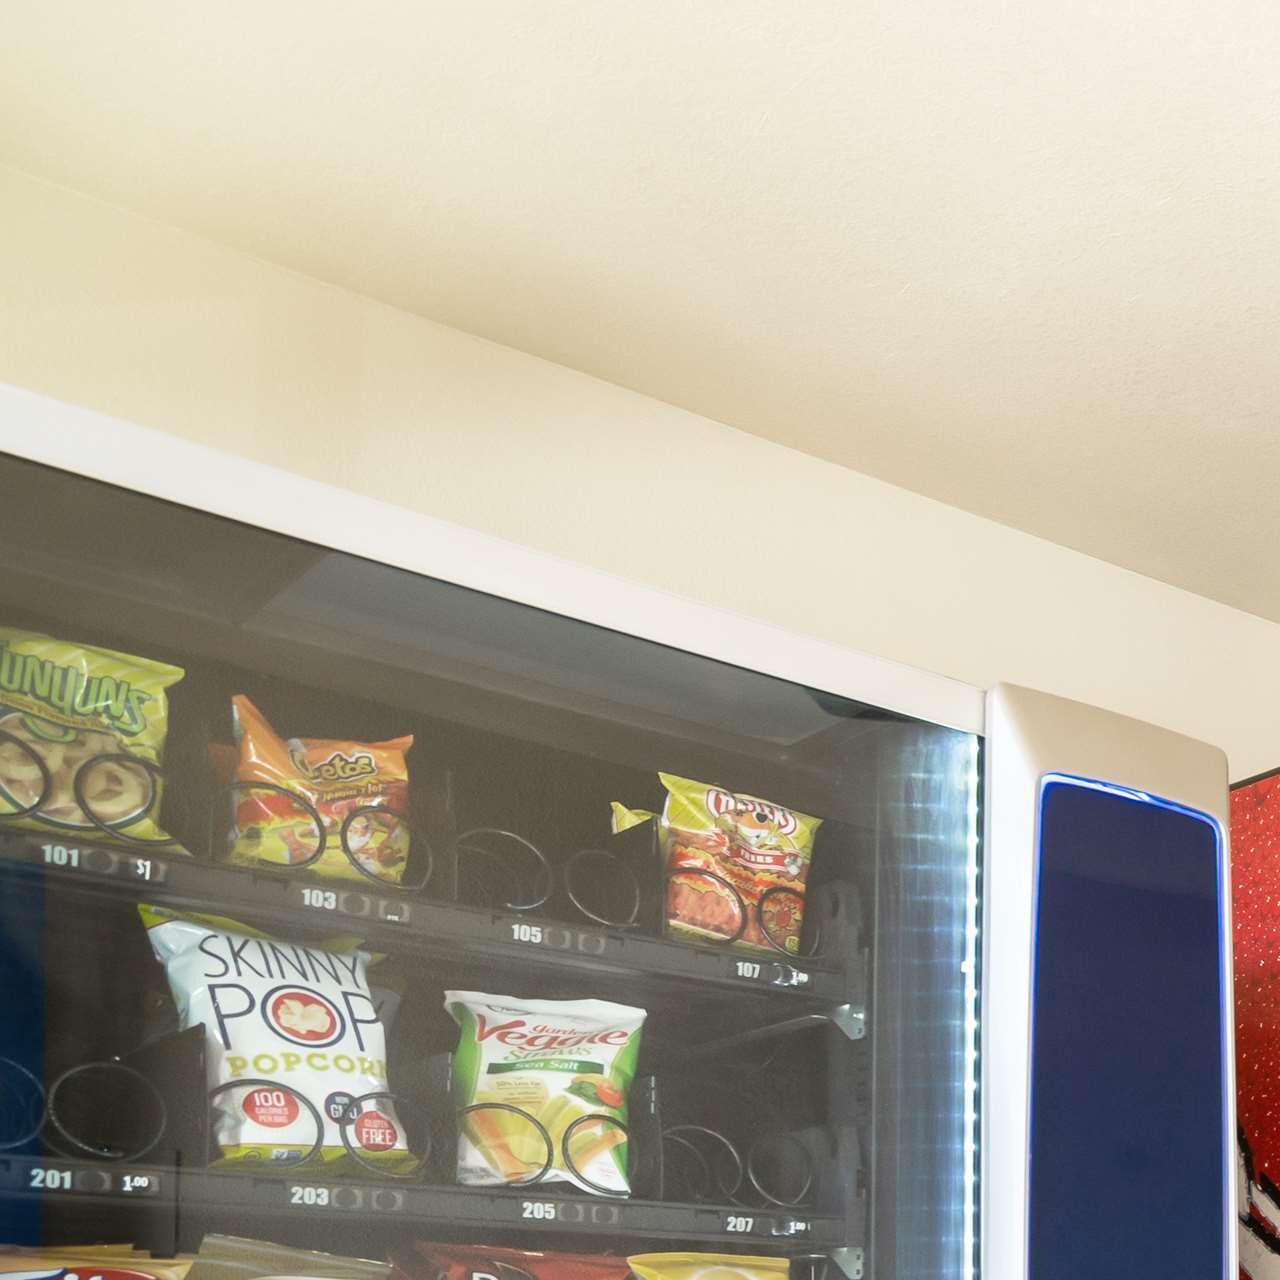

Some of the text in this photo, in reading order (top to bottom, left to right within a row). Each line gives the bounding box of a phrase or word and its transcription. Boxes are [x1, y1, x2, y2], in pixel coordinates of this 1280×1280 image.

[0, 641, 152, 743] UNYUNS
[41, 844, 79, 868] 101
[302, 889, 337, 910] 103
[511, 924, 543, 943] 105
[199, 935, 361, 989] SKINNY
[735, 960, 761, 979] 107
[208, 983, 381, 1052] POP
[476, 1013, 629, 1051] Veggie
[550, 1060, 580, 1070] Salt
[254, 1091, 285, 1107] 100
[362, 1128, 394, 1146] FREE
[30, 1168, 149, 1192] 201 1.00
[291, 1186, 329, 1206] 203
[521, 1201, 555, 1220] 205
[726, 1216, 754, 1233] 207
